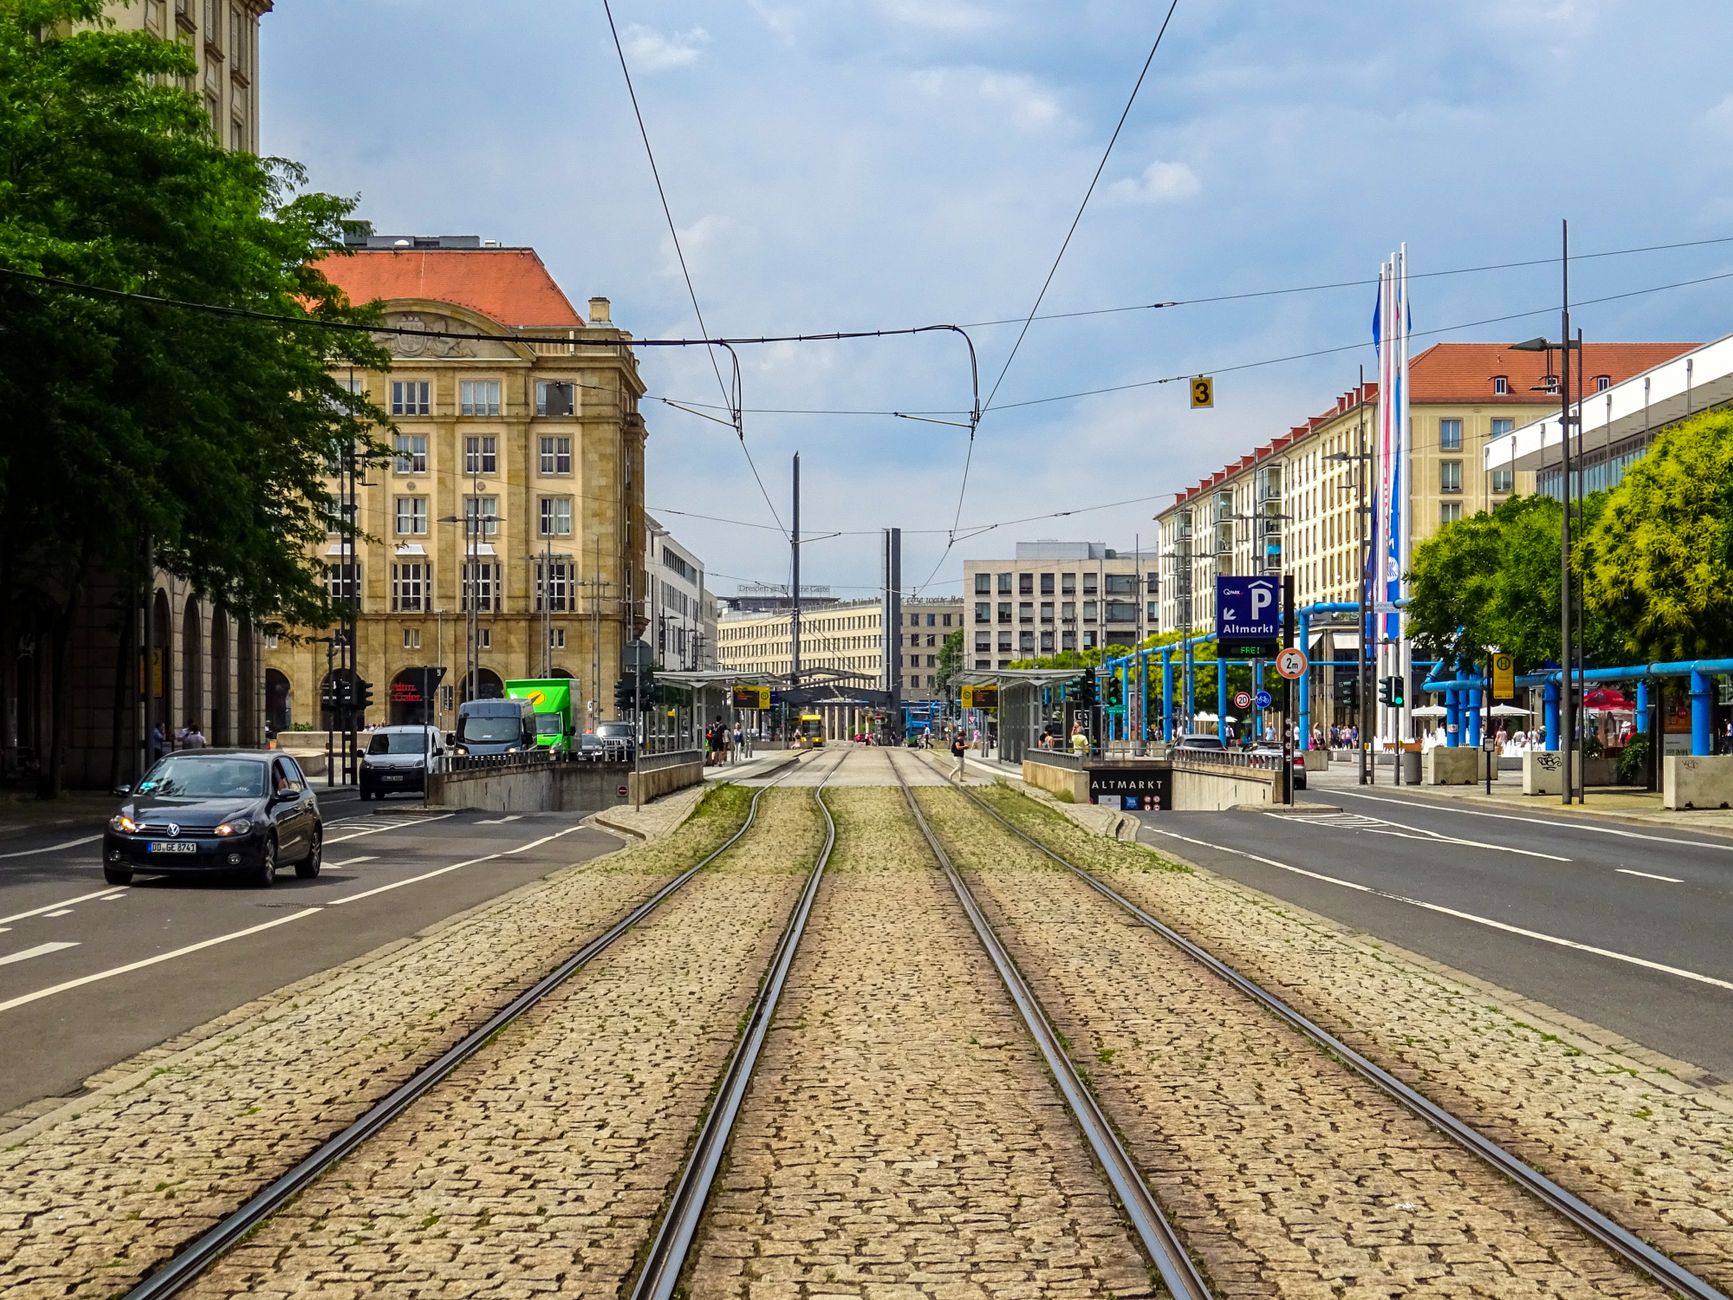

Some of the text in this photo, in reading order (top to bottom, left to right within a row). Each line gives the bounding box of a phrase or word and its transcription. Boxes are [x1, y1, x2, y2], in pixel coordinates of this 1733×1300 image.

[1195, 382, 1210, 404] 3
[1251, 588, 1272, 620] P
[1223, 624, 1274, 633] Altmarkt
[1240, 646, 1260, 654] FREI
[1238, 696, 1247, 704] 20
[1091, 780, 1163, 789] ALTMARKT
